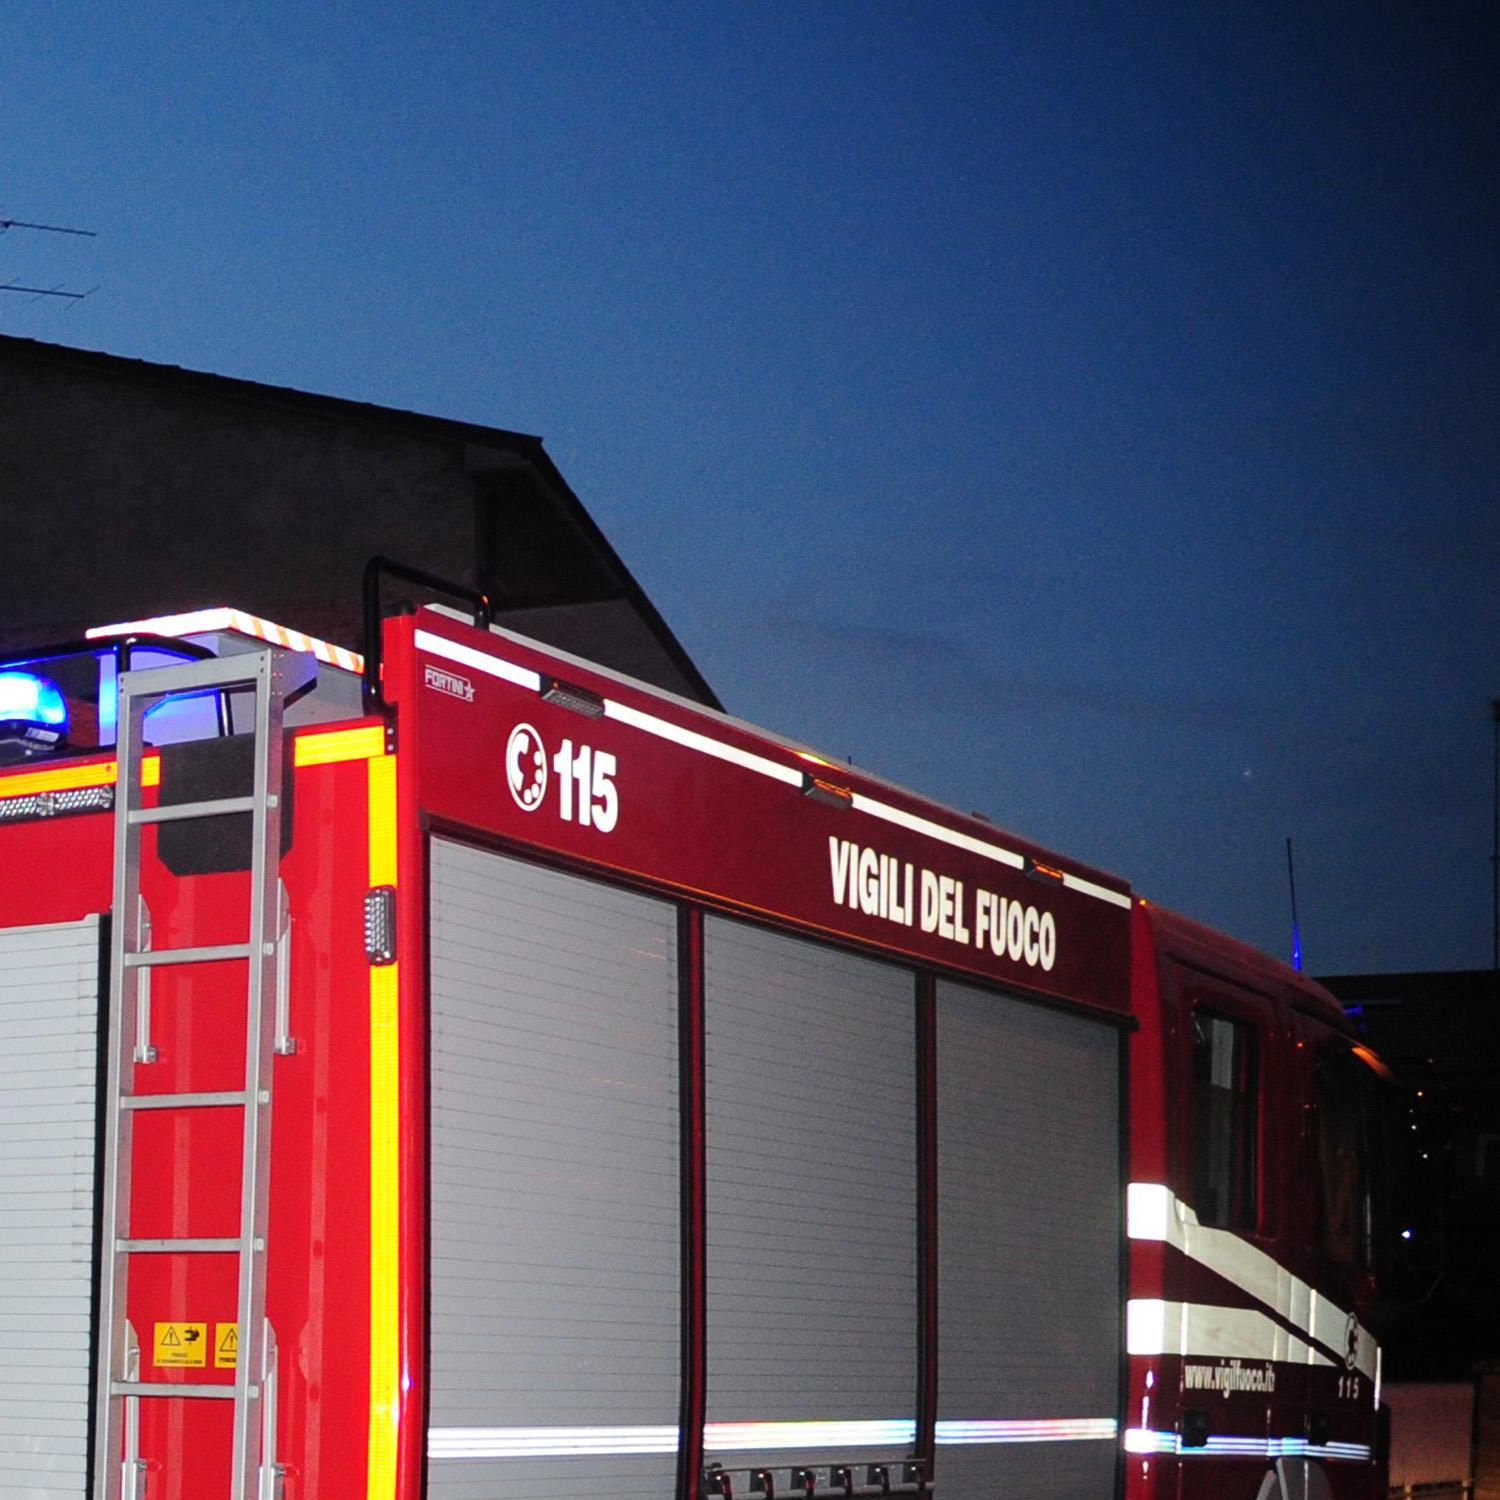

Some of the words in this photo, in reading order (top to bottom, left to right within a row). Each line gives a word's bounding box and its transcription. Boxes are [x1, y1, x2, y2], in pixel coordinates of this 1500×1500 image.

[552, 738, 619, 833] 115
[828, 835, 914, 927] VIGILI
[920, 868, 970, 945] DEL
[975, 887, 1056, 972] FUOCO
